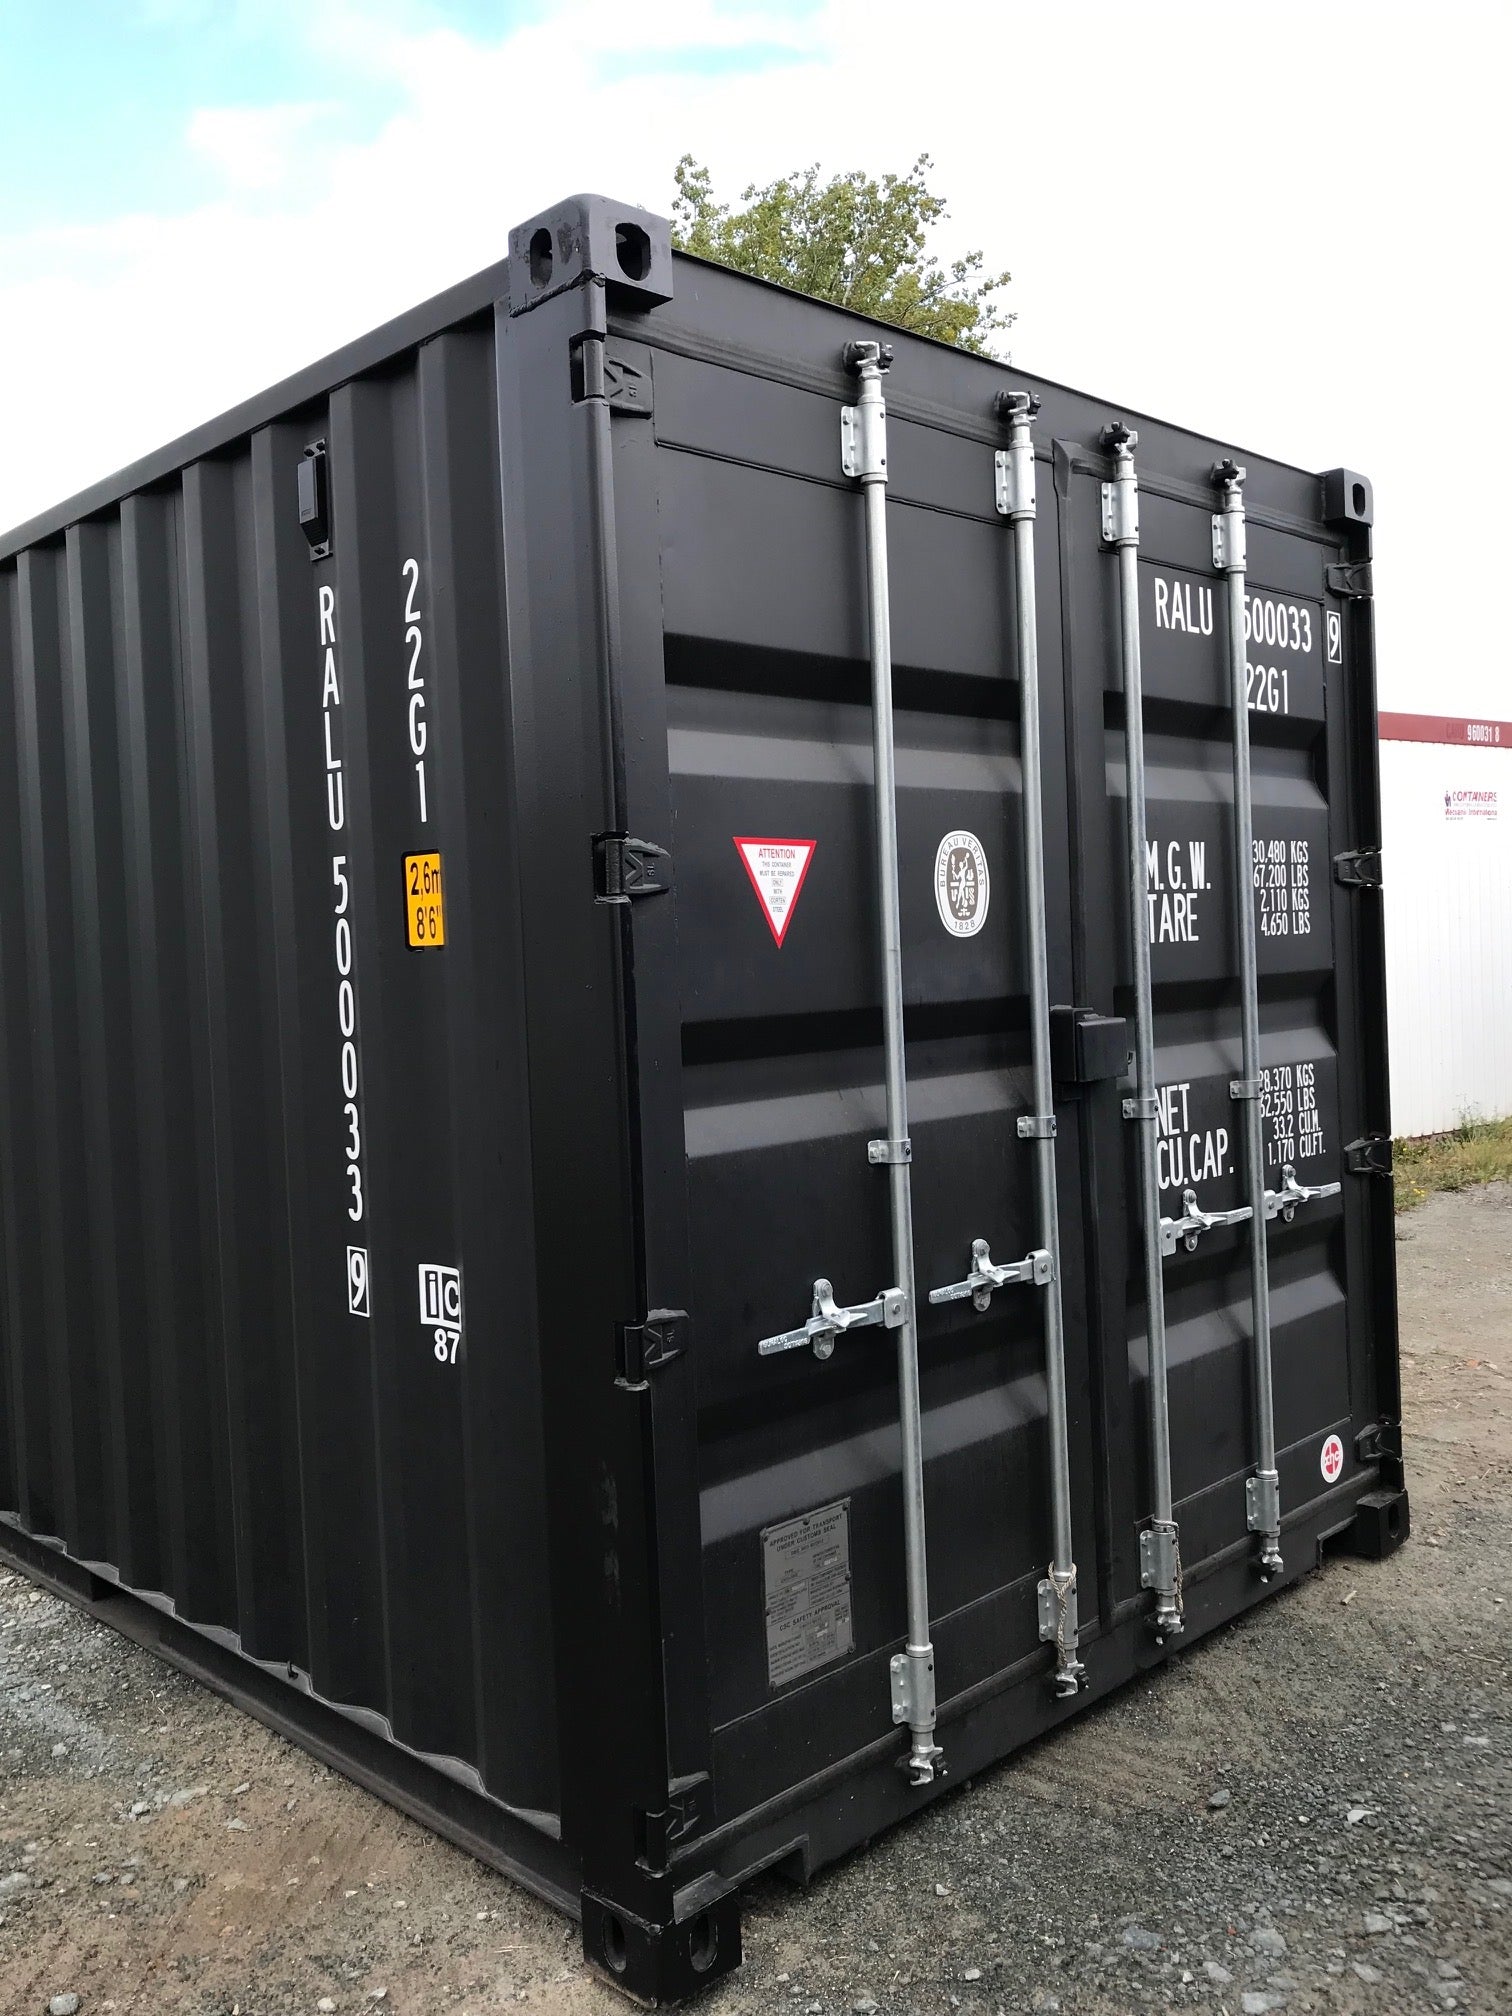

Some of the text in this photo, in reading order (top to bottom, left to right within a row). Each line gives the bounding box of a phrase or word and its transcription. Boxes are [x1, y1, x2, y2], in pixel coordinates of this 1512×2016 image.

[1154, 577, 1214, 636] RALU
[1243, 594, 1312, 653] 500033
[403, 558, 427, 822] 22G1
[1245, 661, 1289, 714] 22G1
[758, 848, 796, 859] ATTENTION
[940, 837, 985, 887] BUREAU VERITAS
[1146, 840, 1211, 890] M.G.W.
[1290, 840, 1309, 864] KGS
[1291, 864, 1309, 888] LBS
[318, 585, 344, 830] RALU
[333, 855, 363, 1221] 500033
[954, 920, 975, 931] 1828
[1148, 892, 1199, 943] TARE
[1292, 888, 1310, 911] KGS
[1292, 911, 1311, 935] LBS
[1154, 1082, 1190, 1137] NET
[1296, 1063, 1315, 1088] KGS
[1297, 1087, 1315, 1112] LBS
[1157, 1128, 1234, 1190] CU.CAP.
[1273, 1114, 1294, 1140] 33.2
[434, 1328, 460, 1364] 87
